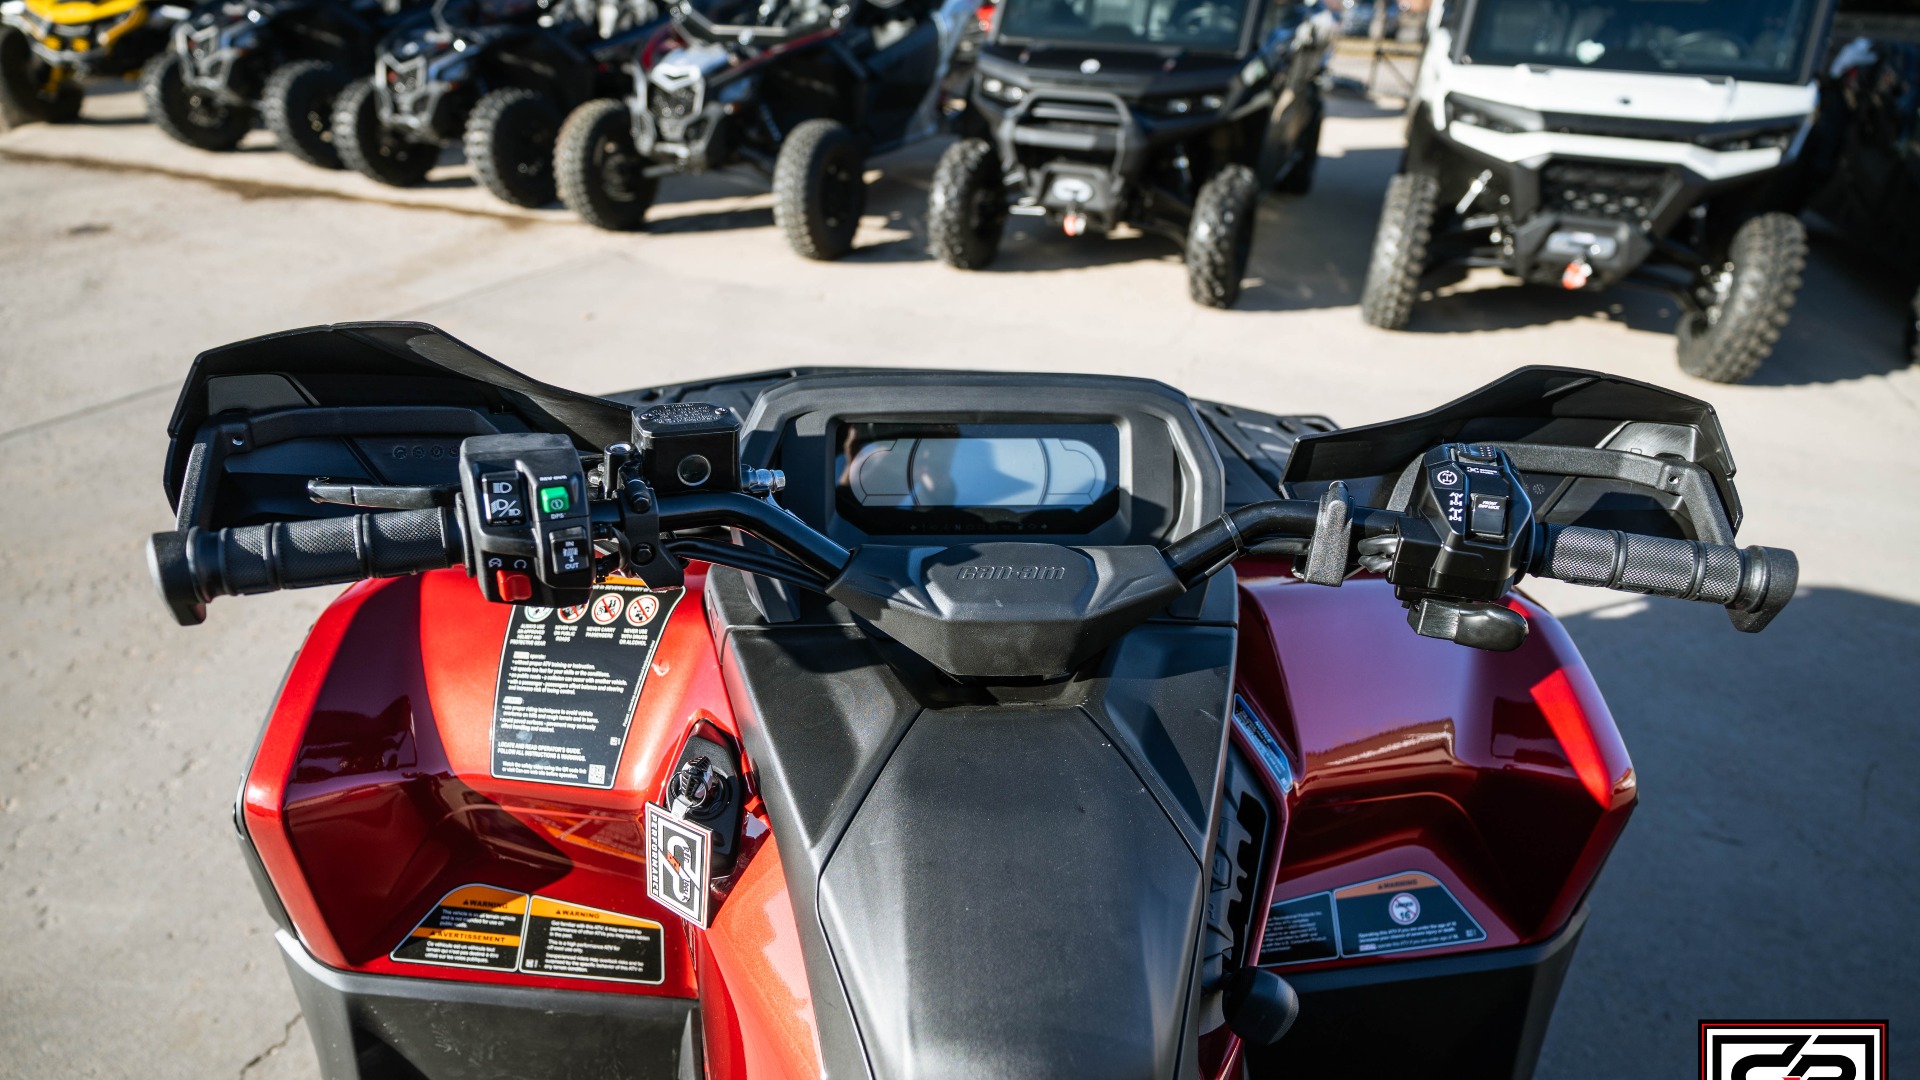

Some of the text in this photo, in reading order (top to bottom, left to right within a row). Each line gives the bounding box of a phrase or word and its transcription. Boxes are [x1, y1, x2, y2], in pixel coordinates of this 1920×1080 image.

[957, 566, 1065, 580] can-am
[650, 813, 660, 897] PERFORMANCE
[470, 900, 507, 909] WARNING
[562, 910, 600, 919] WARNING
[1400, 910, 1411, 920] 16
[437, 931, 505, 942] AVERTISSEMENT
